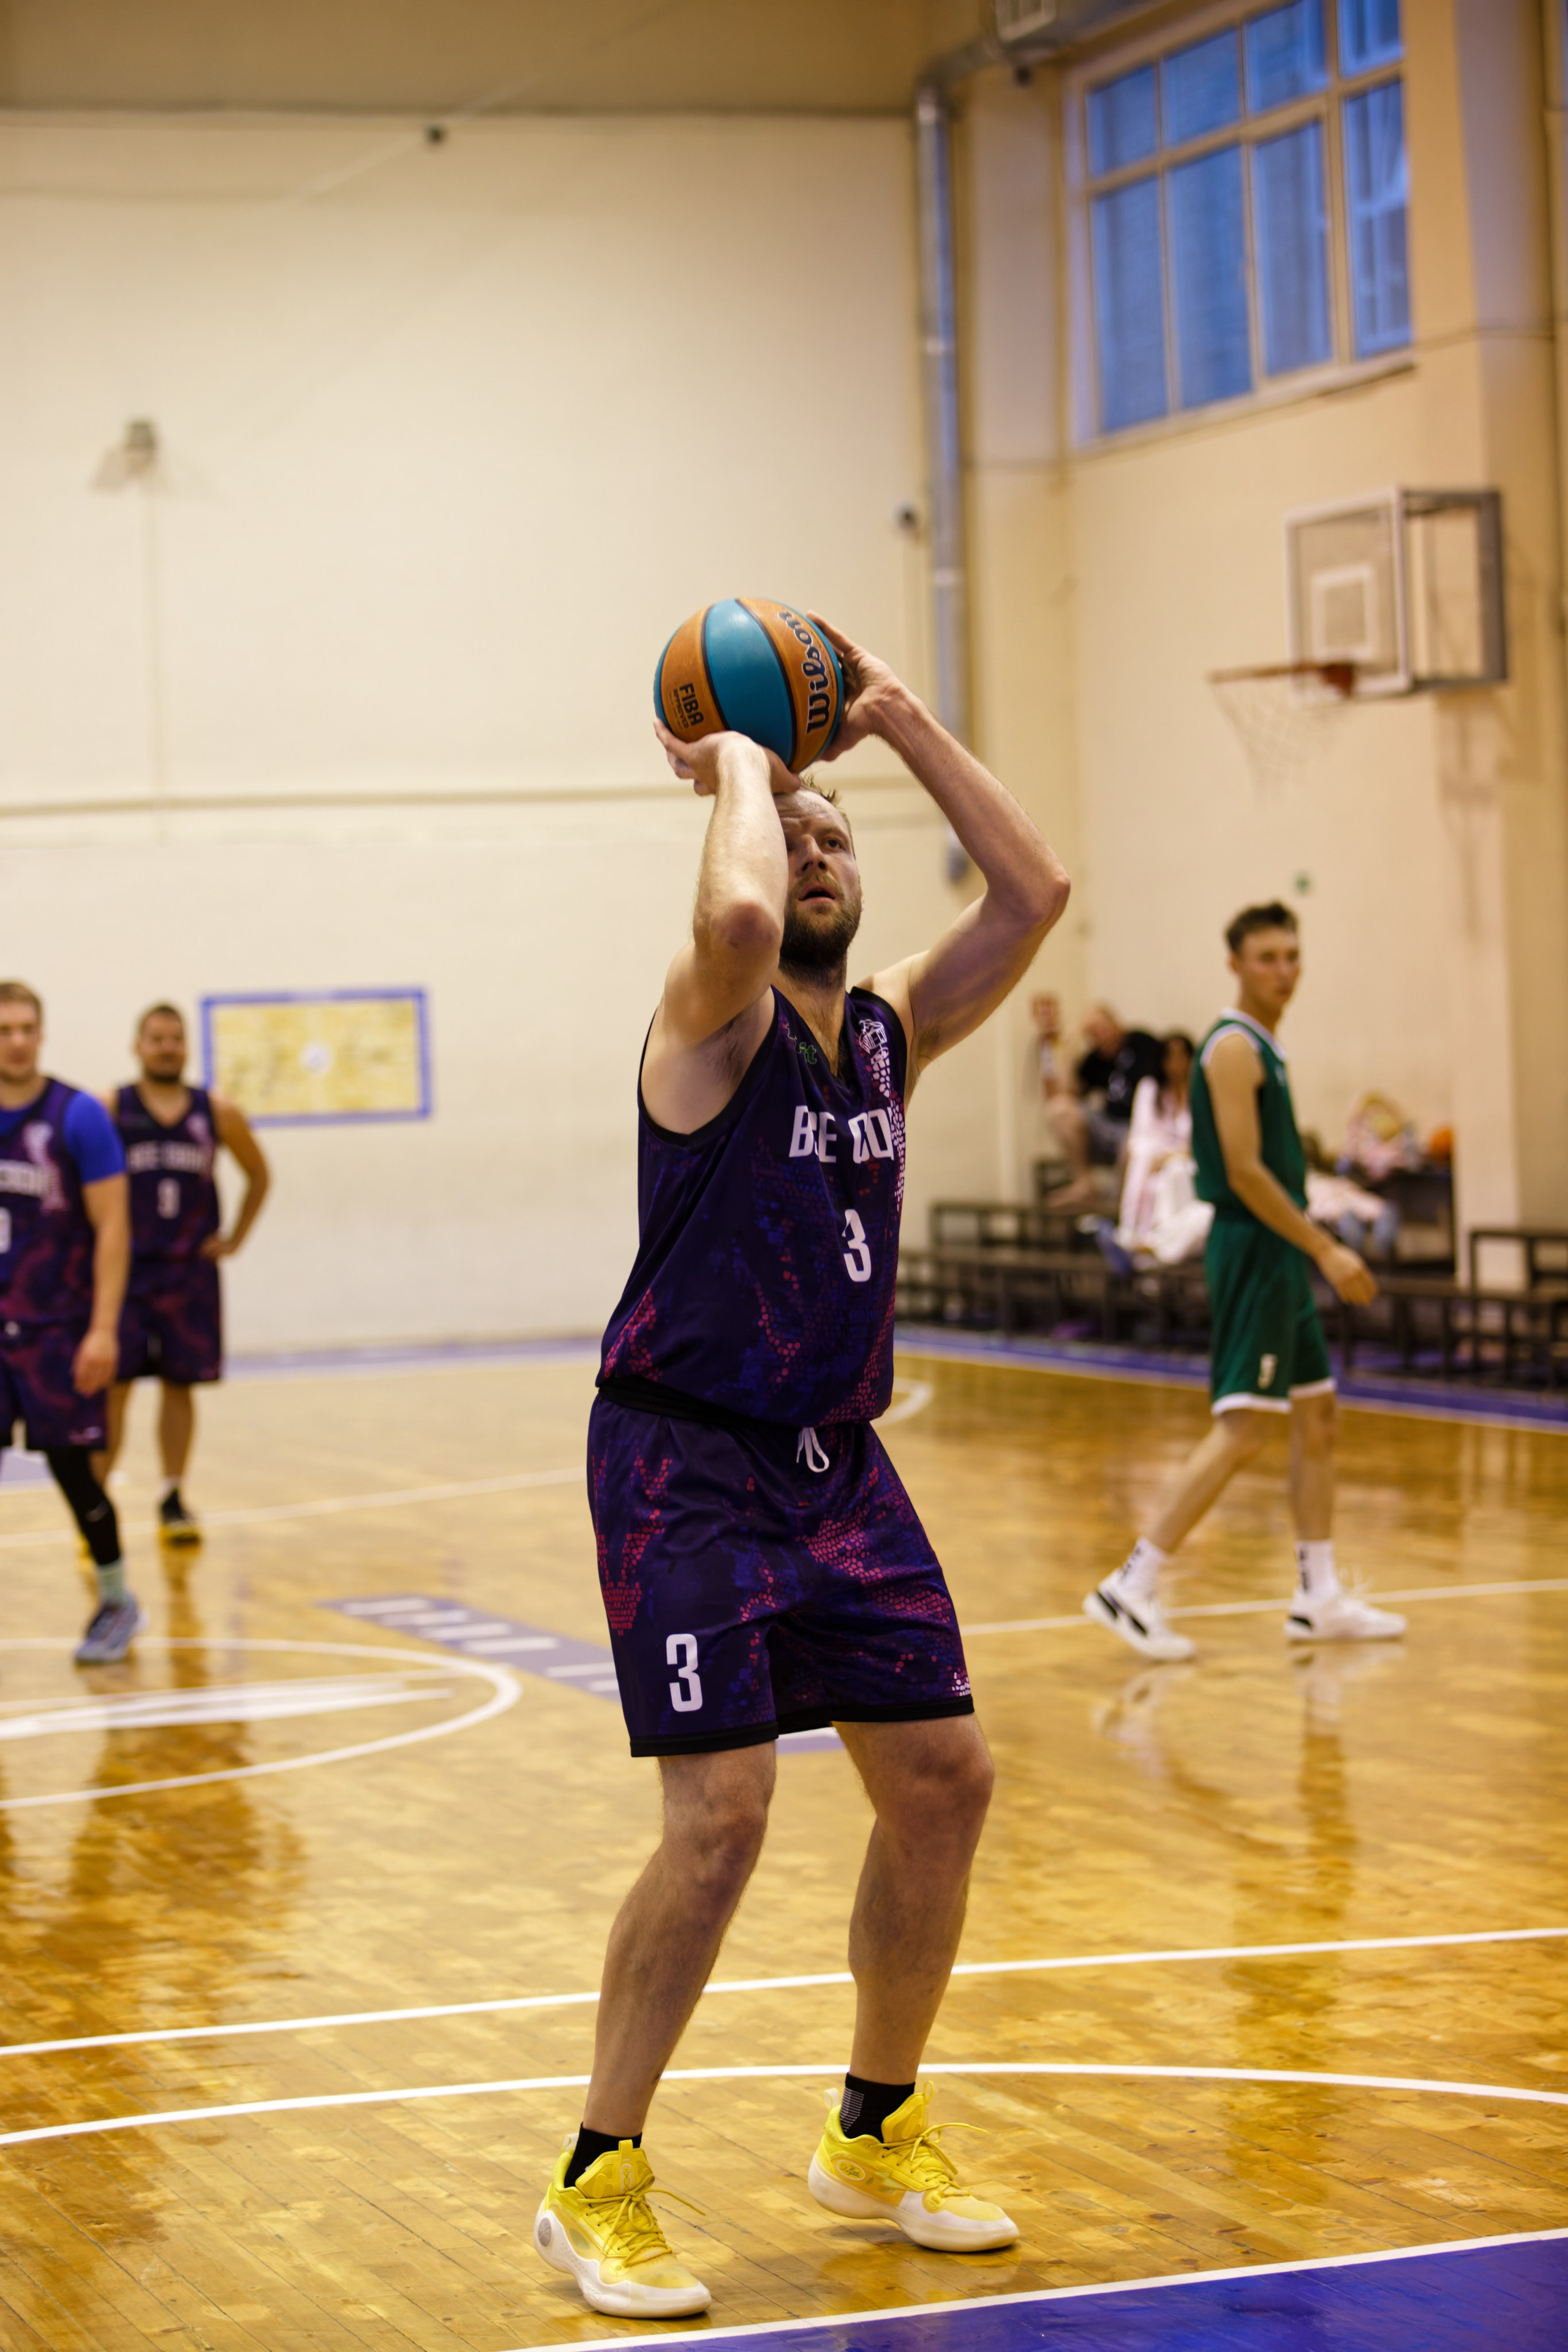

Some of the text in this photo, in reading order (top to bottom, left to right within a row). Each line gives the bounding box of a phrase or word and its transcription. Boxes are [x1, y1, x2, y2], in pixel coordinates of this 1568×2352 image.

[679, 682, 704, 726] FIBA
[777, 610, 831, 736] Wilson
[841, 1208, 872, 1282] 3
[665, 1633, 703, 1713] 3
